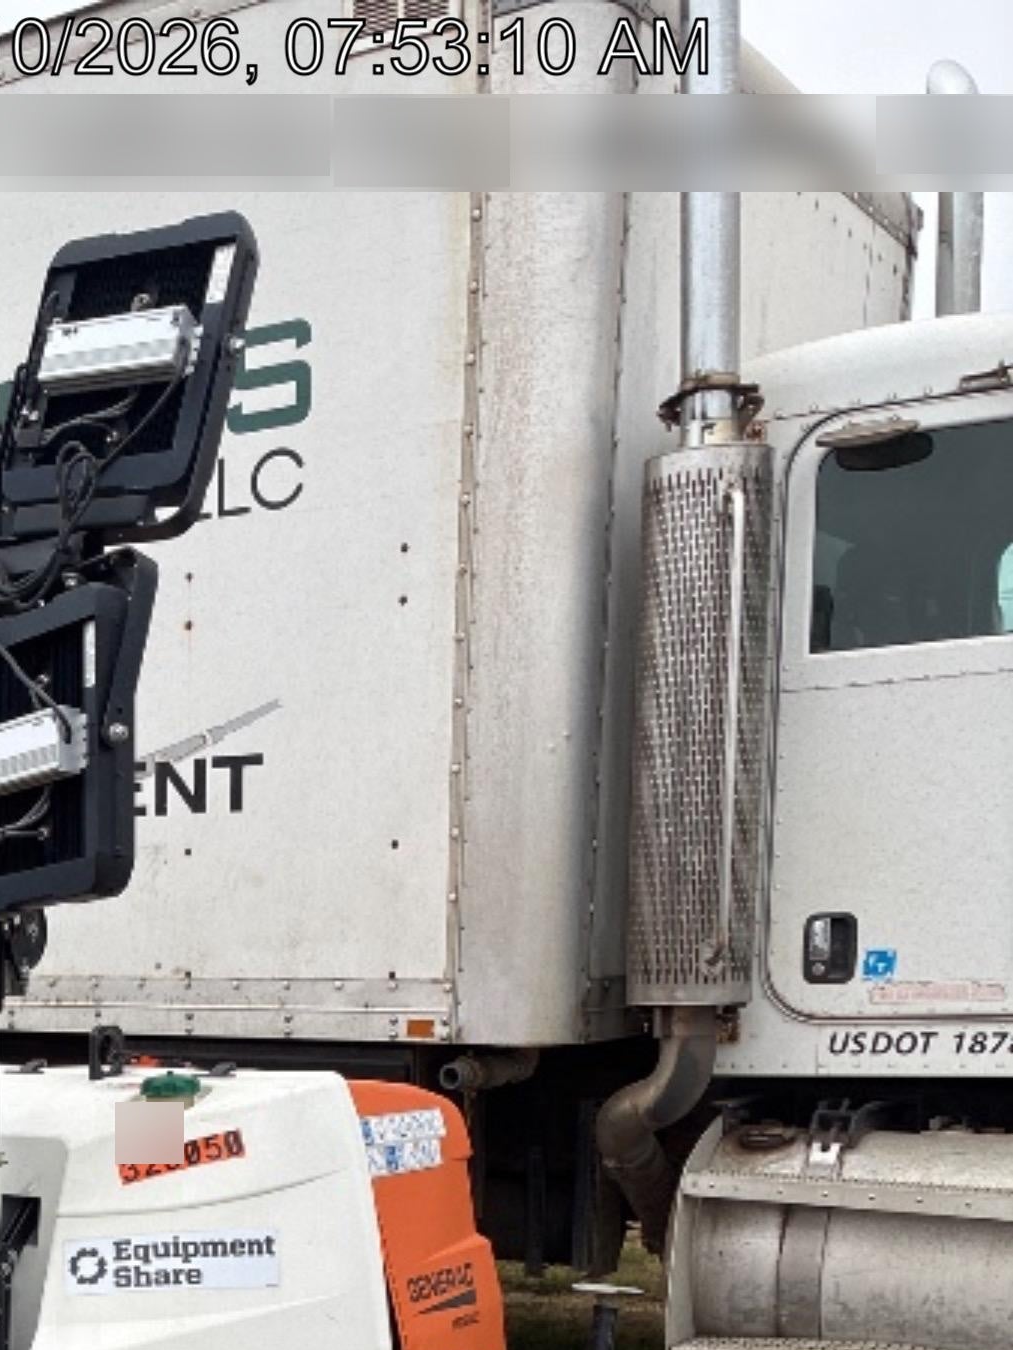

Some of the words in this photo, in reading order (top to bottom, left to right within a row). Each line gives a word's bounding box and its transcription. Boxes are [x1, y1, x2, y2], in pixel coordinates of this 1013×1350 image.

[199, 447, 305, 521] LC
[828, 1031, 939, 1055] USDOT
[112, 1235, 276, 1264] Equipment
[113, 1265, 202, 1288] Share
